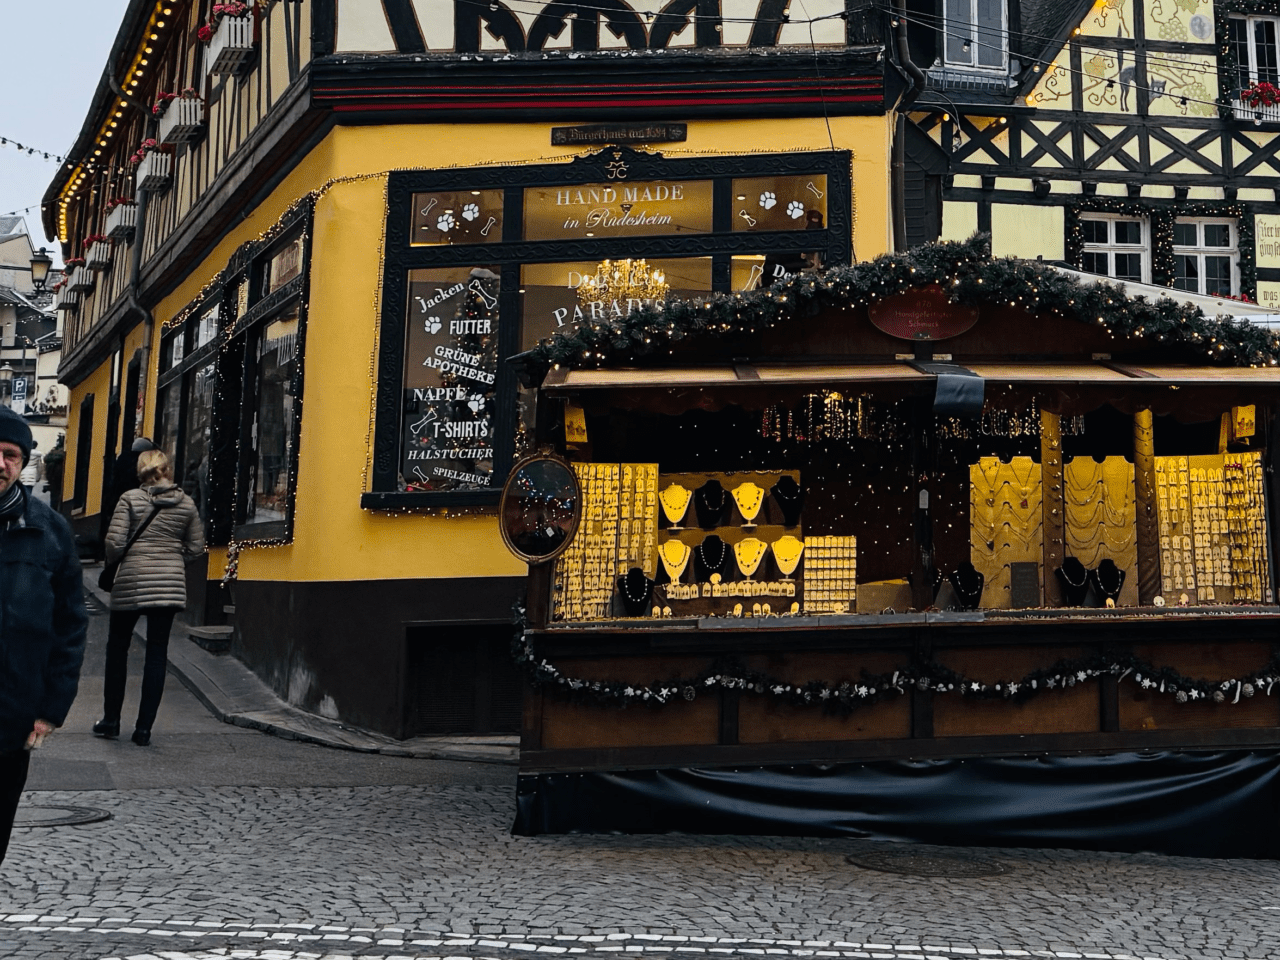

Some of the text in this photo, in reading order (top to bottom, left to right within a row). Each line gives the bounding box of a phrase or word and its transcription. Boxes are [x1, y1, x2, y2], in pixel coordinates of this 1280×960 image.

[556, 185, 684, 206] HAND MADE
[563, 217, 580, 229] in
[419, 282, 465, 314] Jacken
[449, 319, 492, 335] FUTTER
[434, 345, 480, 367] GRÜNE
[422, 356, 496, 385] APOTHEKE
[15, 380, 24, 391] P
[413, 385, 467, 401] NÄPFE
[433, 420, 488, 438] T-SHIRTS
[432, 466, 491, 486] SPIELZEUGE
